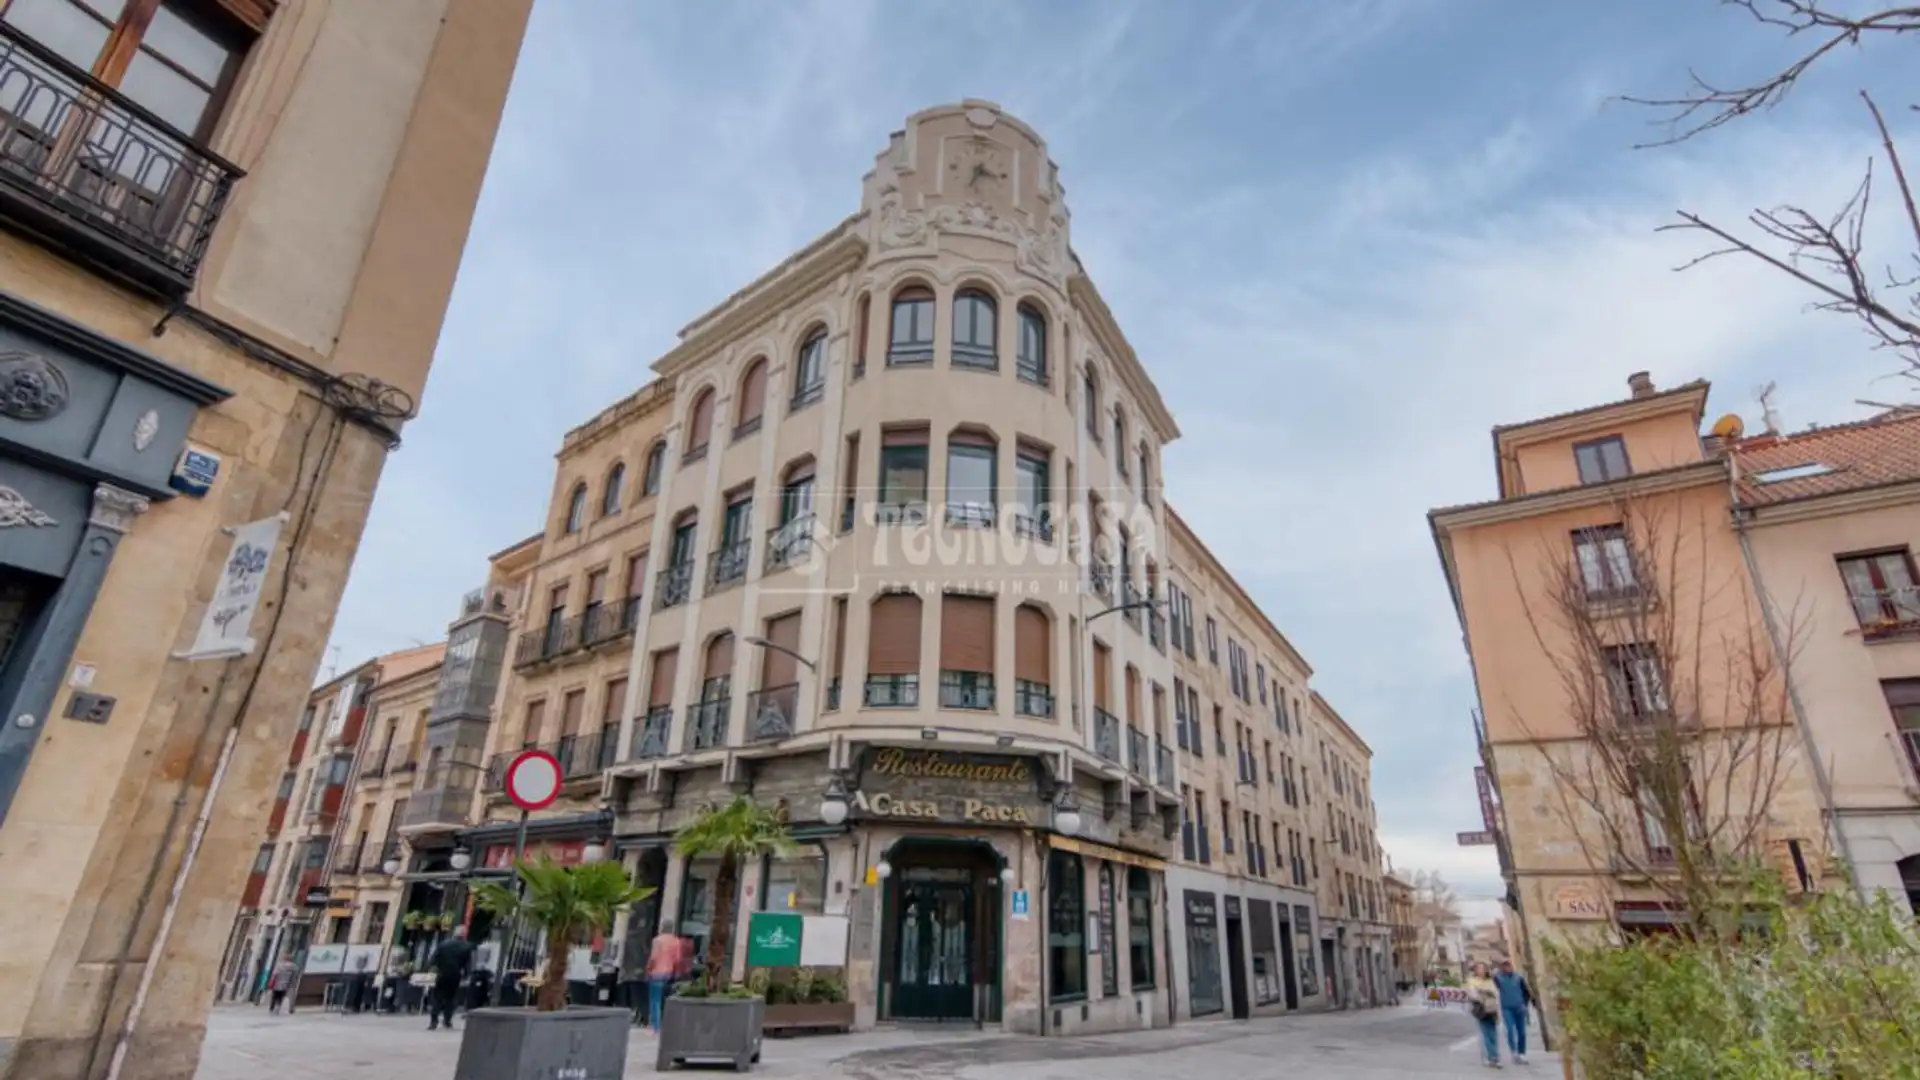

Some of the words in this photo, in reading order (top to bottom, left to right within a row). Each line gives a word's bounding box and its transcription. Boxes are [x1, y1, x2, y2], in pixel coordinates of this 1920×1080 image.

[873, 748, 1029, 781] Restaurante
[870, 794, 938, 817] Casa
[964, 800, 1027, 823] Paca
